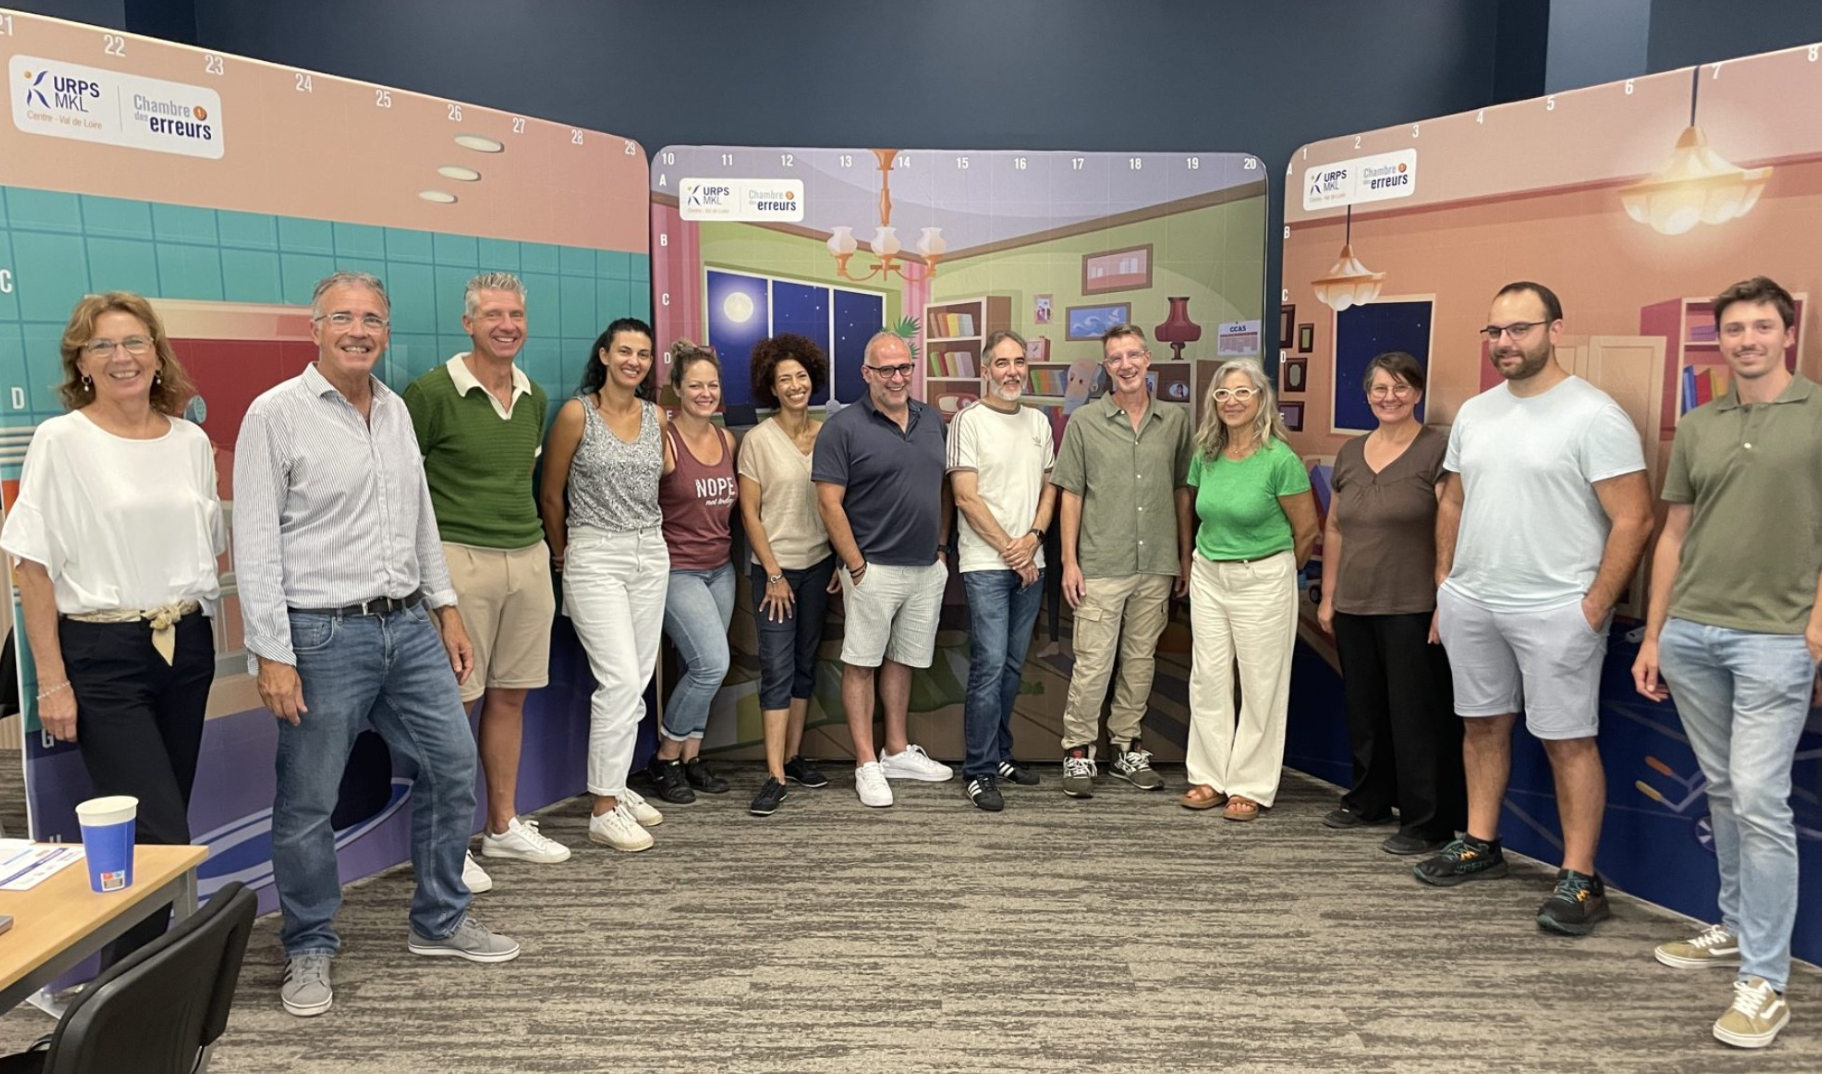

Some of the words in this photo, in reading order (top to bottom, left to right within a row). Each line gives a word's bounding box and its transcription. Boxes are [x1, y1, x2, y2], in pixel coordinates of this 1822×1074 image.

[54, 76, 100, 98] URPS
[104, 35, 126, 57] 22
[205, 55, 224, 75] 23
[295, 73, 312, 93] 24
[376, 89, 391, 108] 25
[448, 104, 462, 122] 26
[513, 117, 525, 134] 27
[571, 129, 583, 145] 28
[625, 140, 636, 155] 29
[55, 92, 88, 113] MKL
[133, 94, 190, 118] Chambre
[1302, 148, 1308, 160] 1
[1354, 136, 1361, 149] 2
[1412, 125, 1420, 138] 3
[1476, 111, 1484, 124] 4
[1546, 97, 1555, 111] 5
[1624, 79, 1633, 95] 6
[1711, 63, 1723, 79] 7
[1808, 46, 1819, 61] 8
[26, 110, 53, 122] Centre
[134, 111, 149, 122] des
[150, 116, 212, 140] erreurs
[662, 152, 675, 165] 10
[722, 154, 733, 166] 11
[781, 154, 794, 167] 12
[839, 155, 852, 168] 13
[898, 156, 910, 168] 14
[956, 157, 969, 169] 15
[1014, 157, 1027, 170] 16
[1072, 158, 1084, 170] 17
[1129, 158, 1142, 170] 18
[1187, 157, 1199, 169] 19
[1244, 157, 1257, 169] 20
[1286, 162, 1293, 175] A
[659, 174, 667, 186] A
[1323, 169, 1347, 182] URPS
[1371, 174, 1408, 189] erreurs
[703, 187, 730, 196] URPS
[1323, 182, 1340, 192] MKL
[703, 196, 722, 205] MKL
[748, 190, 784, 200] Chambre
[757, 200, 796, 211] erreurs
[1284, 226, 1291, 239] B
[660, 234, 668, 246] B
[0, 269, 12, 293] C
[662, 293, 670, 305] C
[1282, 289, 1288, 302] C
[664, 352, 672, 364] D
[1280, 351, 1287, 363] D
[11, 387, 25, 409] D
[695, 477, 736, 498] NOPE
